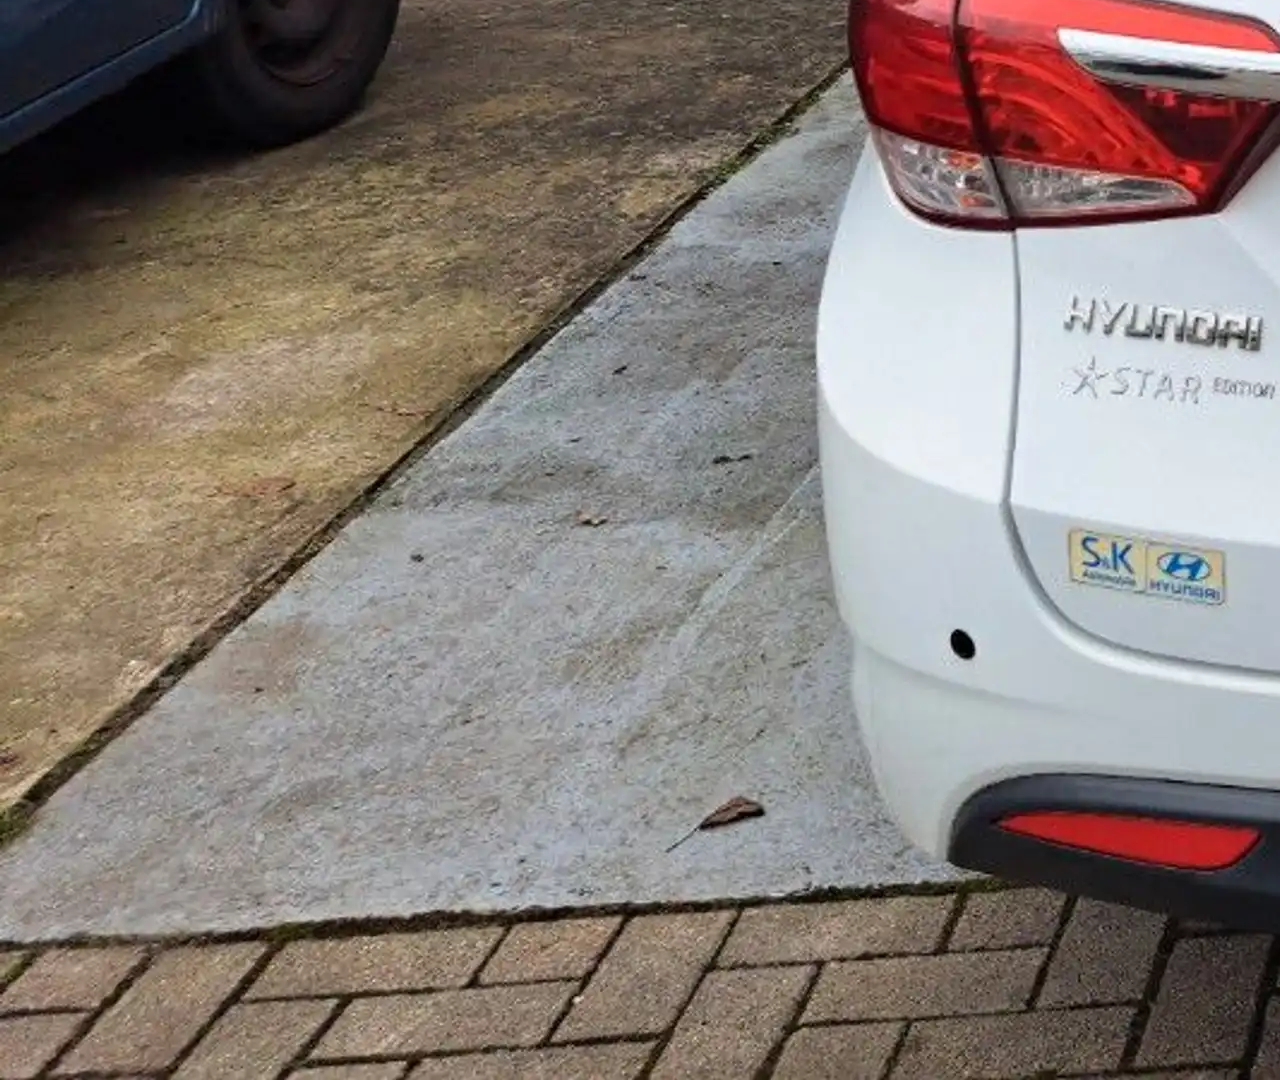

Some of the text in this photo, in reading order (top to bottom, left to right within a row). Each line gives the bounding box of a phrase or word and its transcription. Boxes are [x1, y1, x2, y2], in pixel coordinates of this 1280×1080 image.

[1063, 296, 1263, 352] HYUNDAI
[1111, 367, 1203, 404] STAR
[1150, 578, 1221, 602] HYUNDAI
